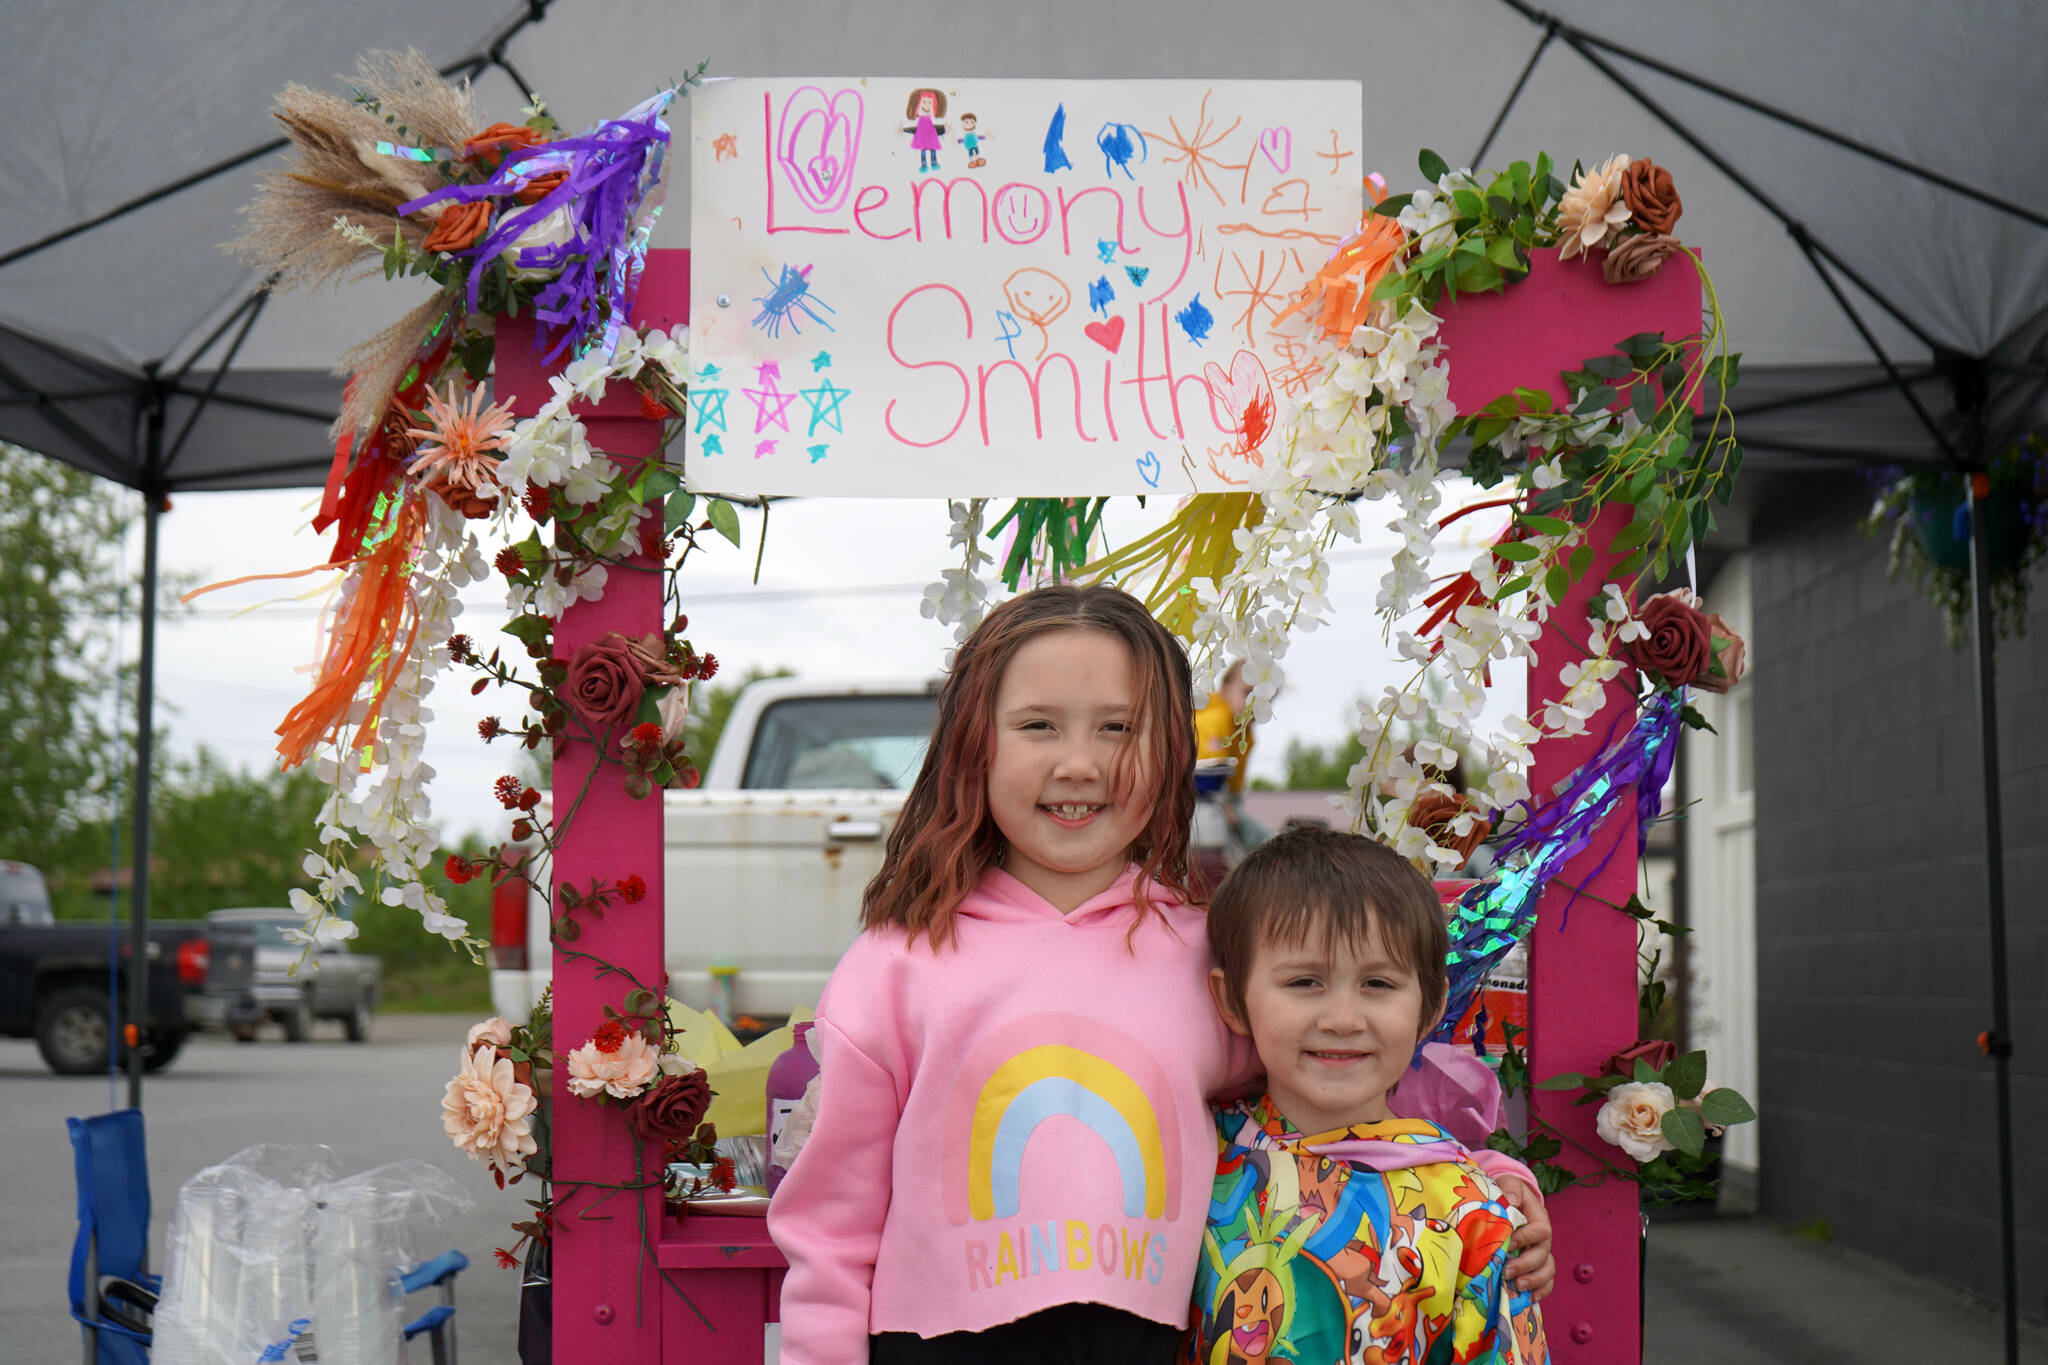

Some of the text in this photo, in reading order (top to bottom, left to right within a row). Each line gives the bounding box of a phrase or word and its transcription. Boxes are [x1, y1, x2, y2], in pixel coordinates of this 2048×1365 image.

[764, 91, 1193, 304] Lemony
[885, 283, 1241, 447] Smith
[1480, 979, 1528, 990] onad
[965, 1219, 1167, 1291] RAINBOWS
